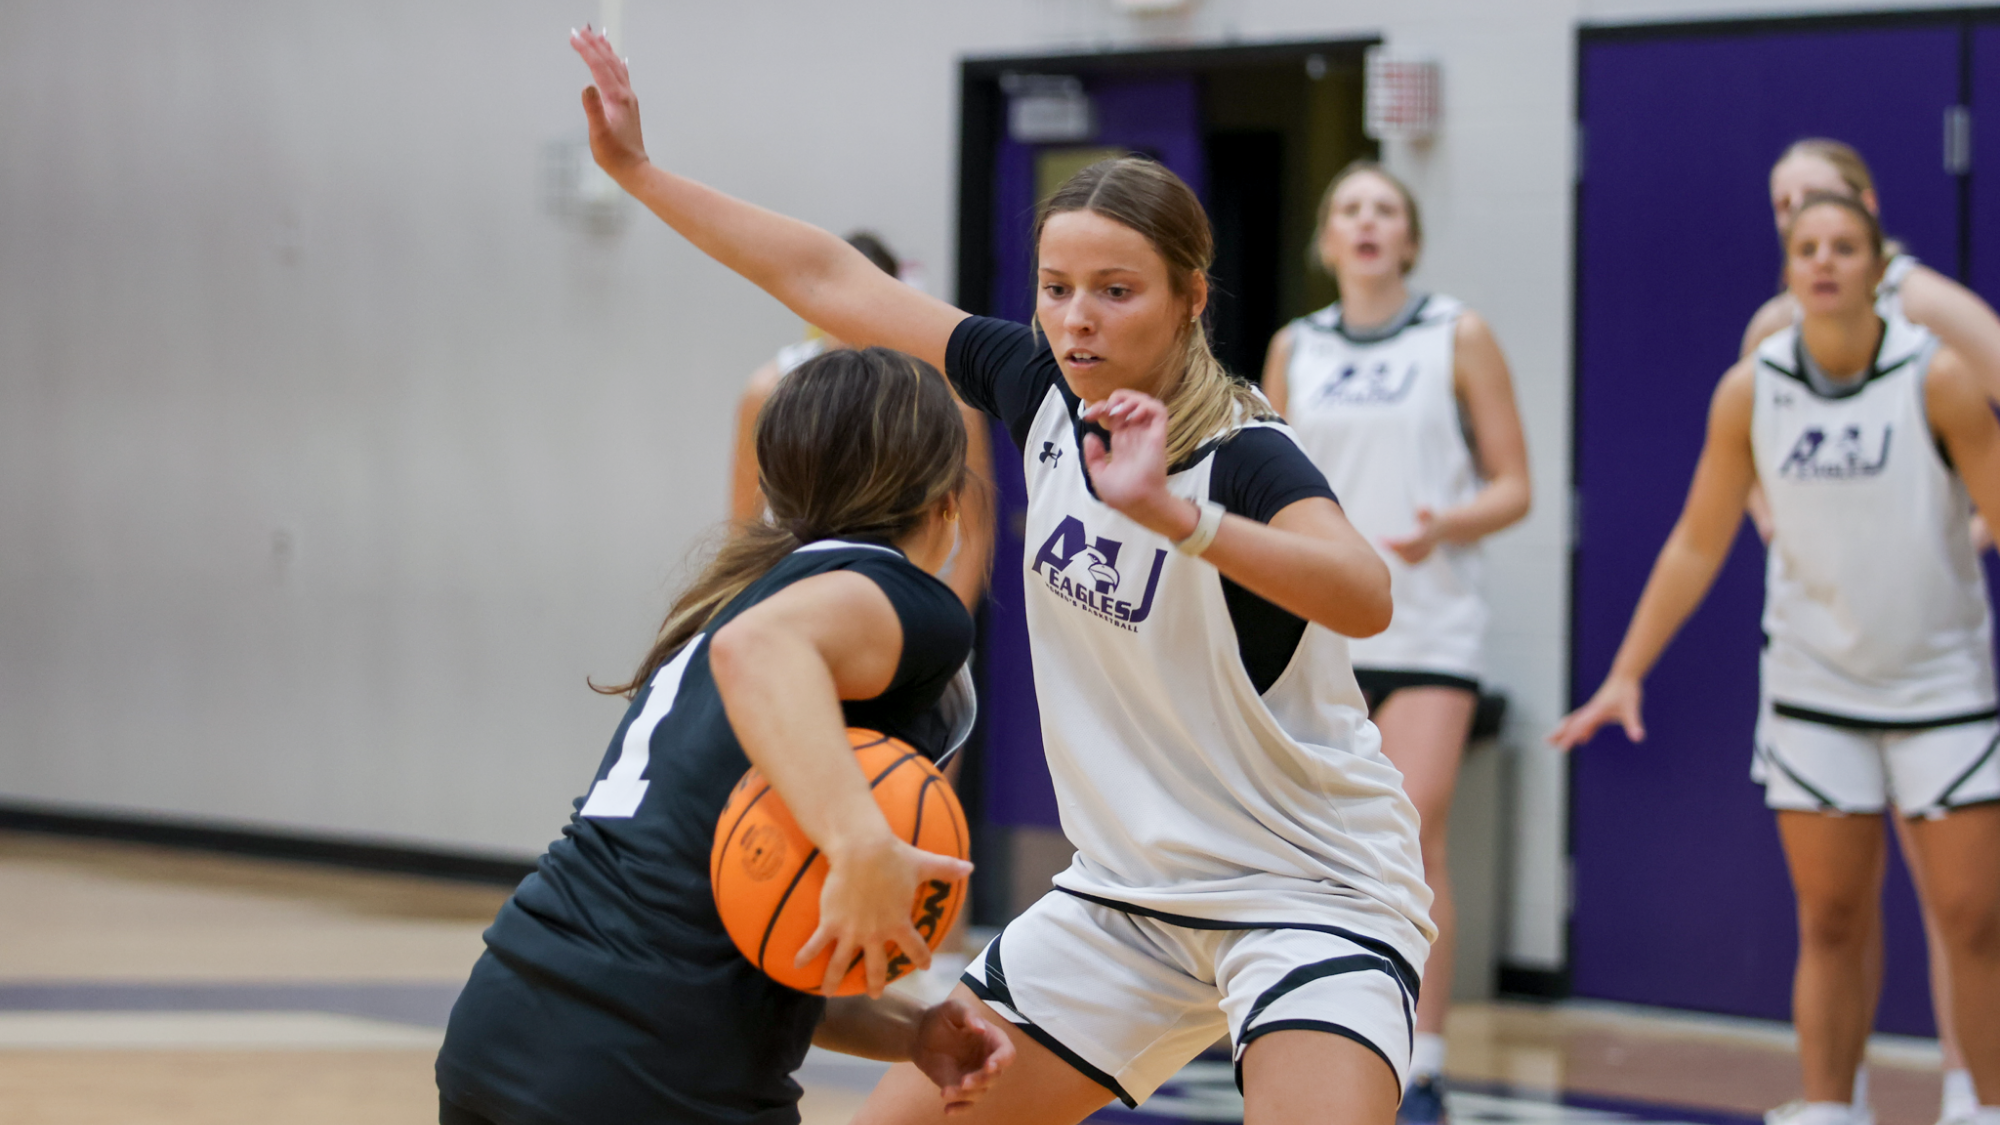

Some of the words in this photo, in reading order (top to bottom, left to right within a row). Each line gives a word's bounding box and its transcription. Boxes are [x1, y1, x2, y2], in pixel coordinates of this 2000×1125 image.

[1049, 566, 1132, 622] EAGLES
[1082, 604, 1139, 634] BASKETBALL
[579, 632, 706, 818] 1
